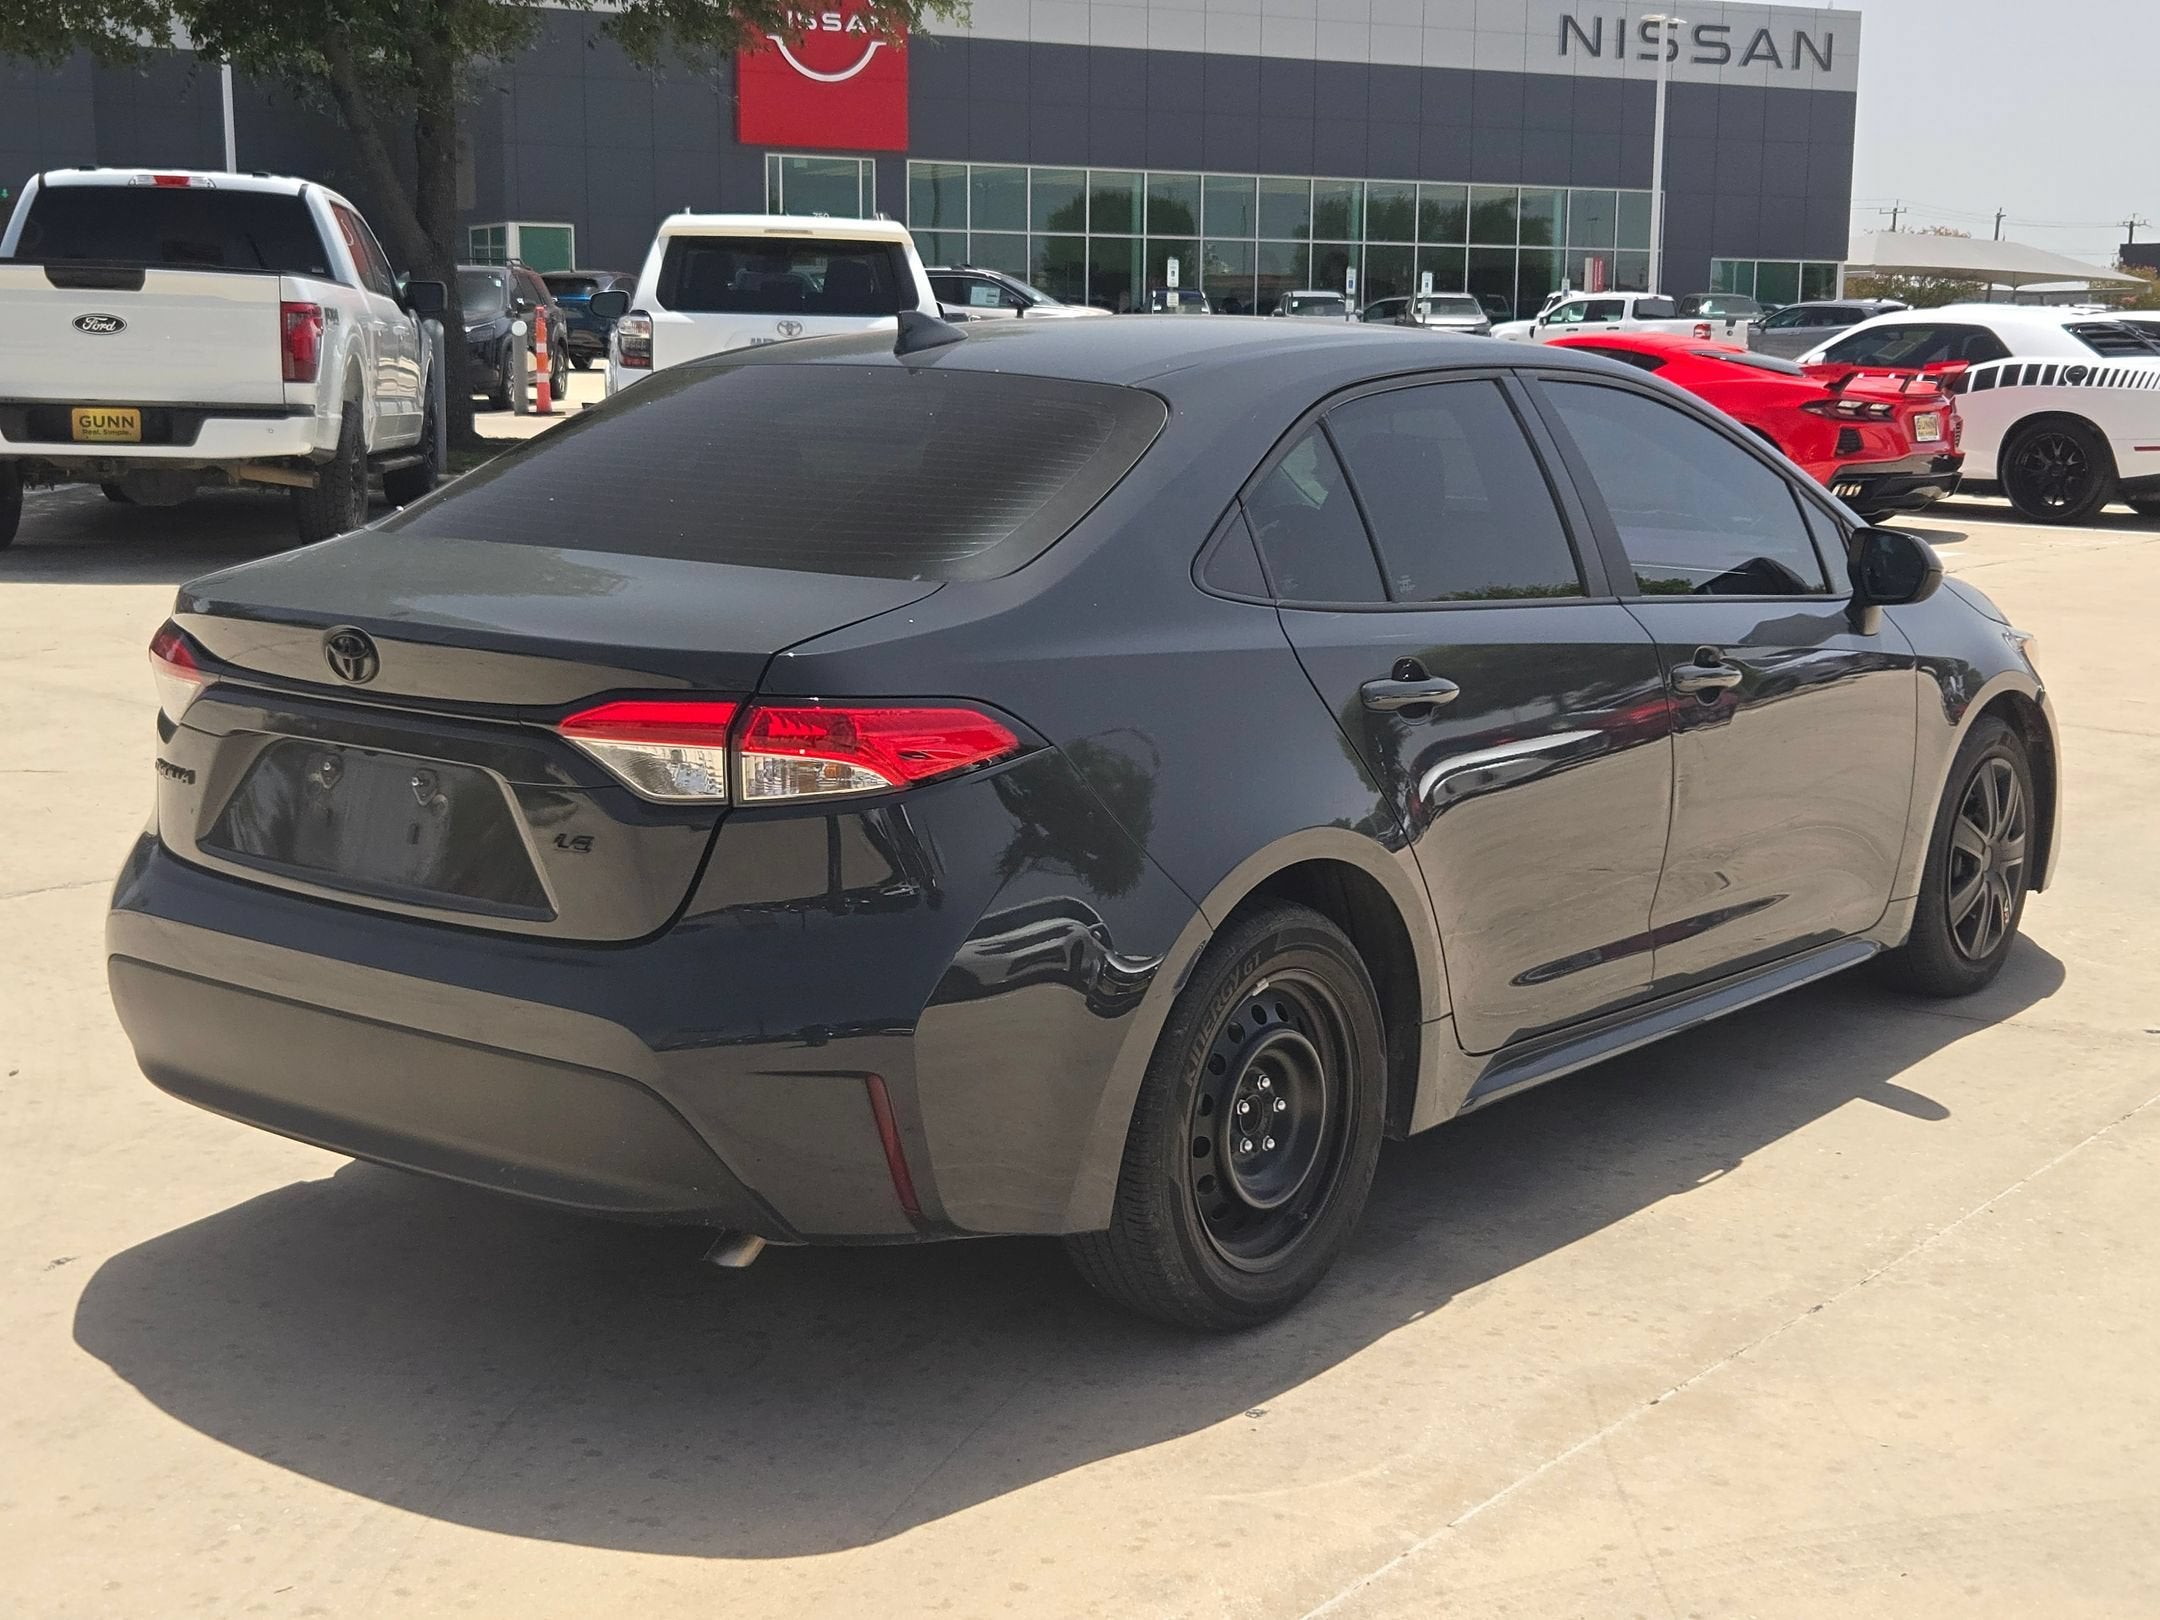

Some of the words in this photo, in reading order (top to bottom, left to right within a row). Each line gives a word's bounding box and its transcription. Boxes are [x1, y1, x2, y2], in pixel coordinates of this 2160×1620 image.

[774, 10, 884, 34] ISSA
[1558, 14, 1834, 72] NISSAN
[82, 316, 117, 331] Ford
[79, 415, 134, 428] GUNN
[1244, 951, 1261, 976] GT
